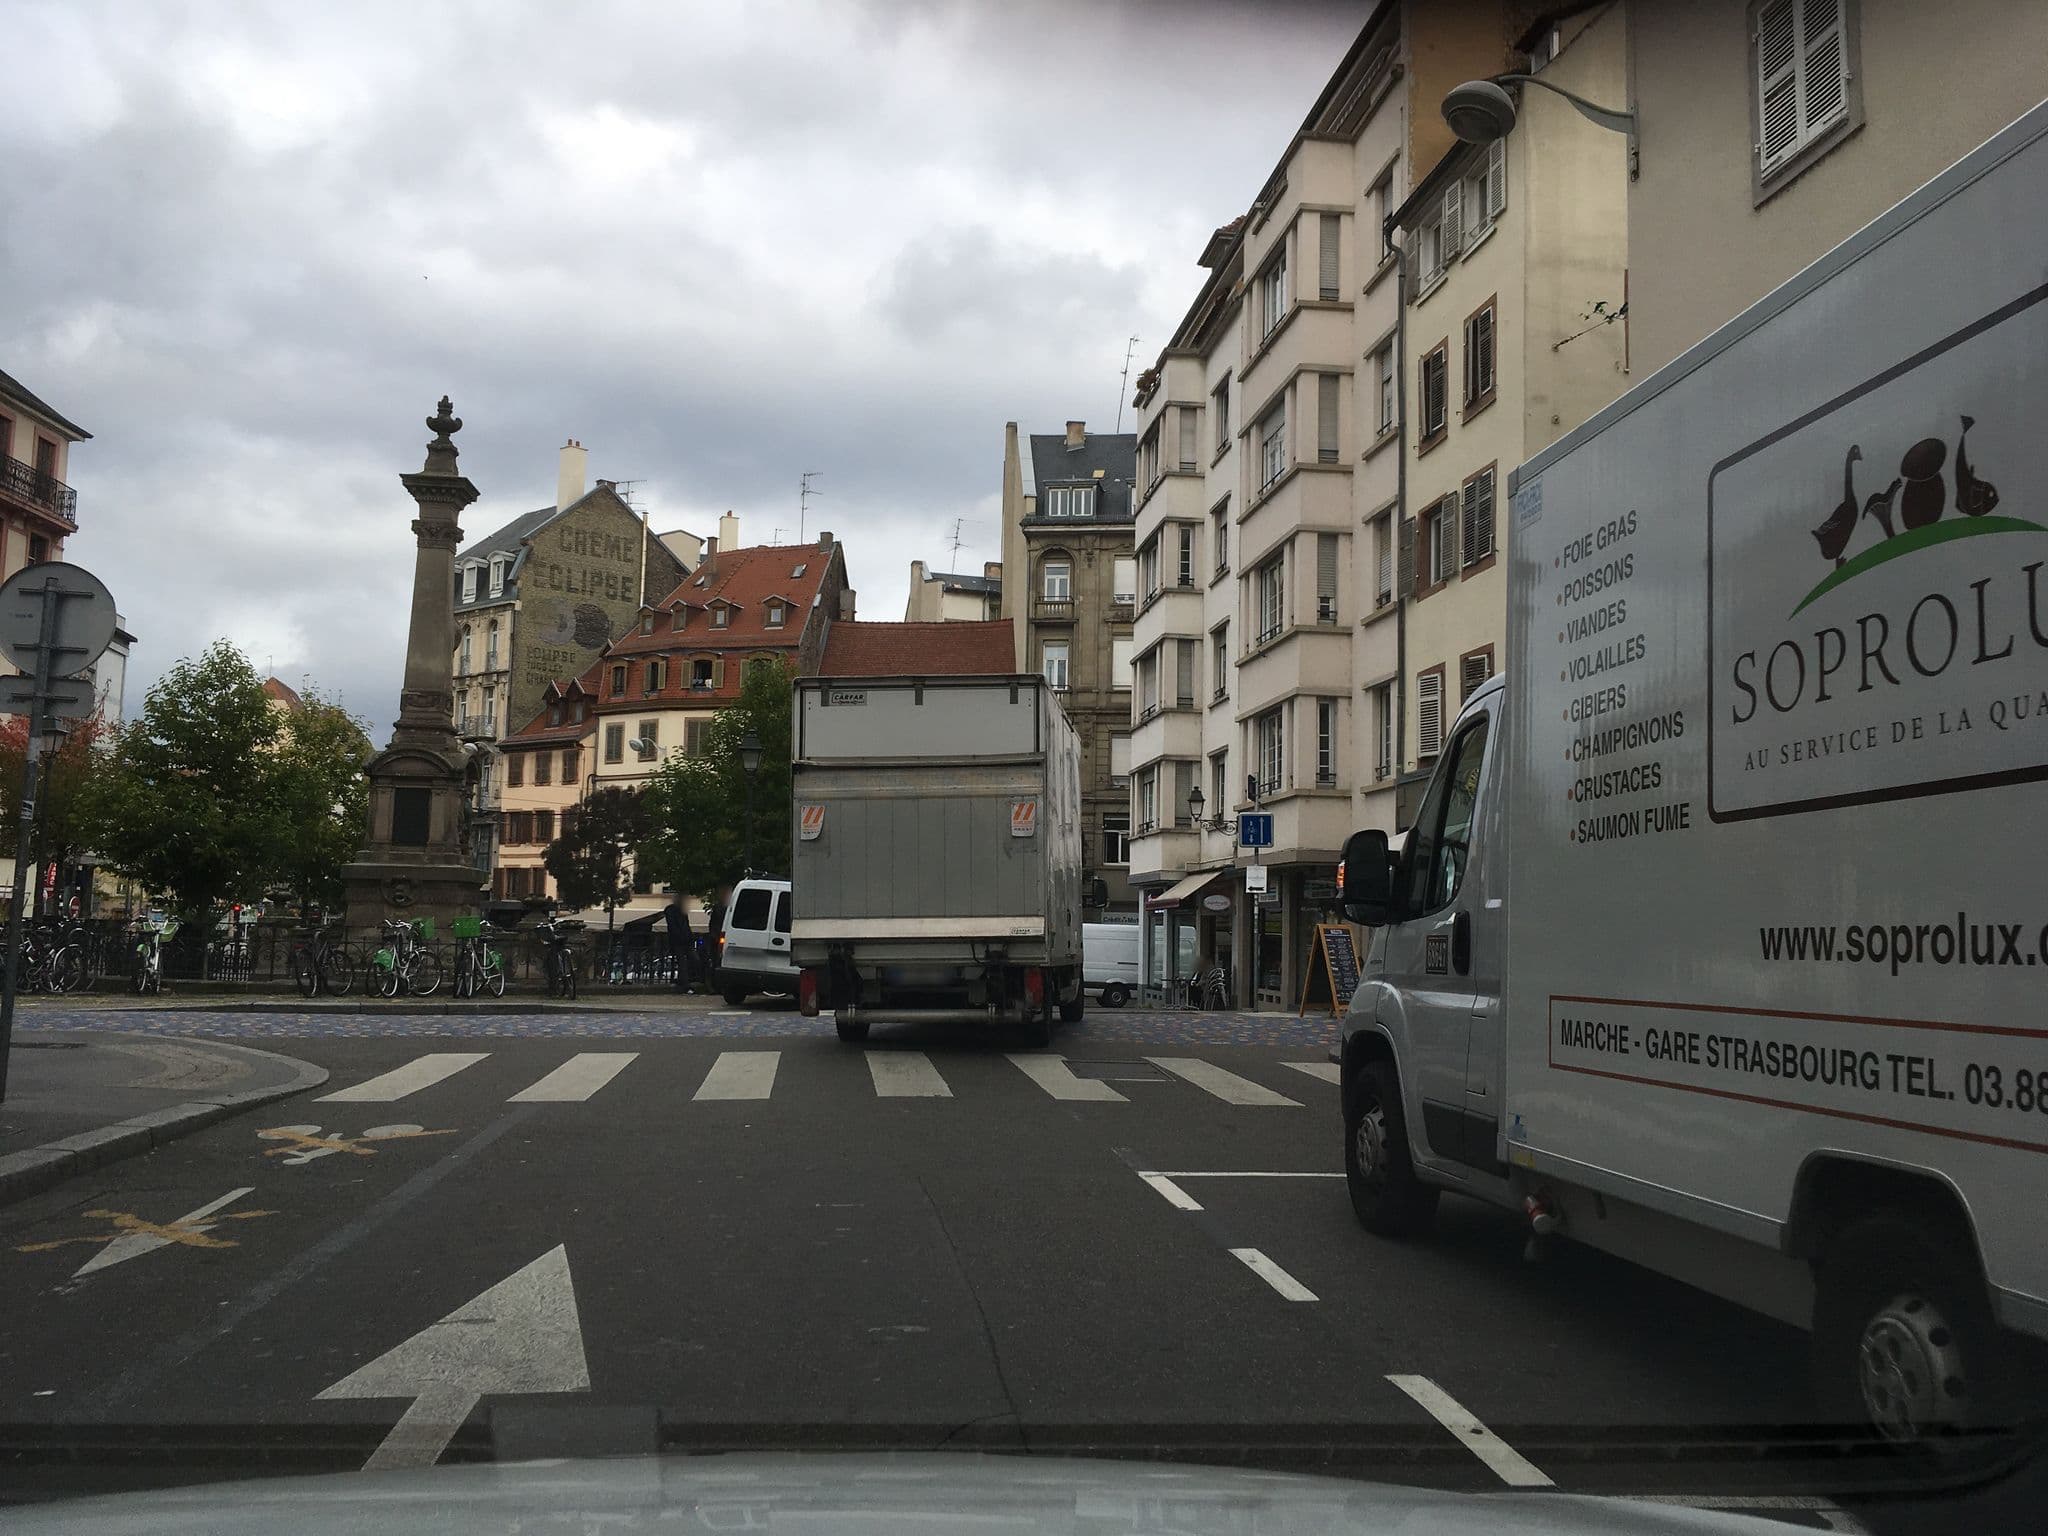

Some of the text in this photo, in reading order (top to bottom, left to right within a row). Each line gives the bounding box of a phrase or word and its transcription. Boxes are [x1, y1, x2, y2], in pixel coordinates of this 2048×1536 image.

[1563, 510, 1637, 568] FOIE GRAS
[1564, 554, 1634, 606] POISSONS
[1567, 599, 1627, 643] VIANDES
[1569, 634, 1646, 683] VOLAILLES
[1571, 684, 1627, 723] GIBIERS
[1572, 711, 1684, 763] CHAMPIGNONS
[1745, 748, 1769, 771] AU
[1780, 727, 1878, 765] SERVICE
[1892, 717, 1924, 745] DE
[1939, 708, 1973, 735] LA
[1574, 762, 1662, 804] CRUSTACES
[1578, 803, 1690, 844] SAUMON FUME
[1561, 1019, 1629, 1055] MARCHE
[1645, 1028, 1700, 1065] GARE
[1706, 1034, 1880, 1090] STRASBOURG
[1887, 1055, 1955, 1100] TEL.
